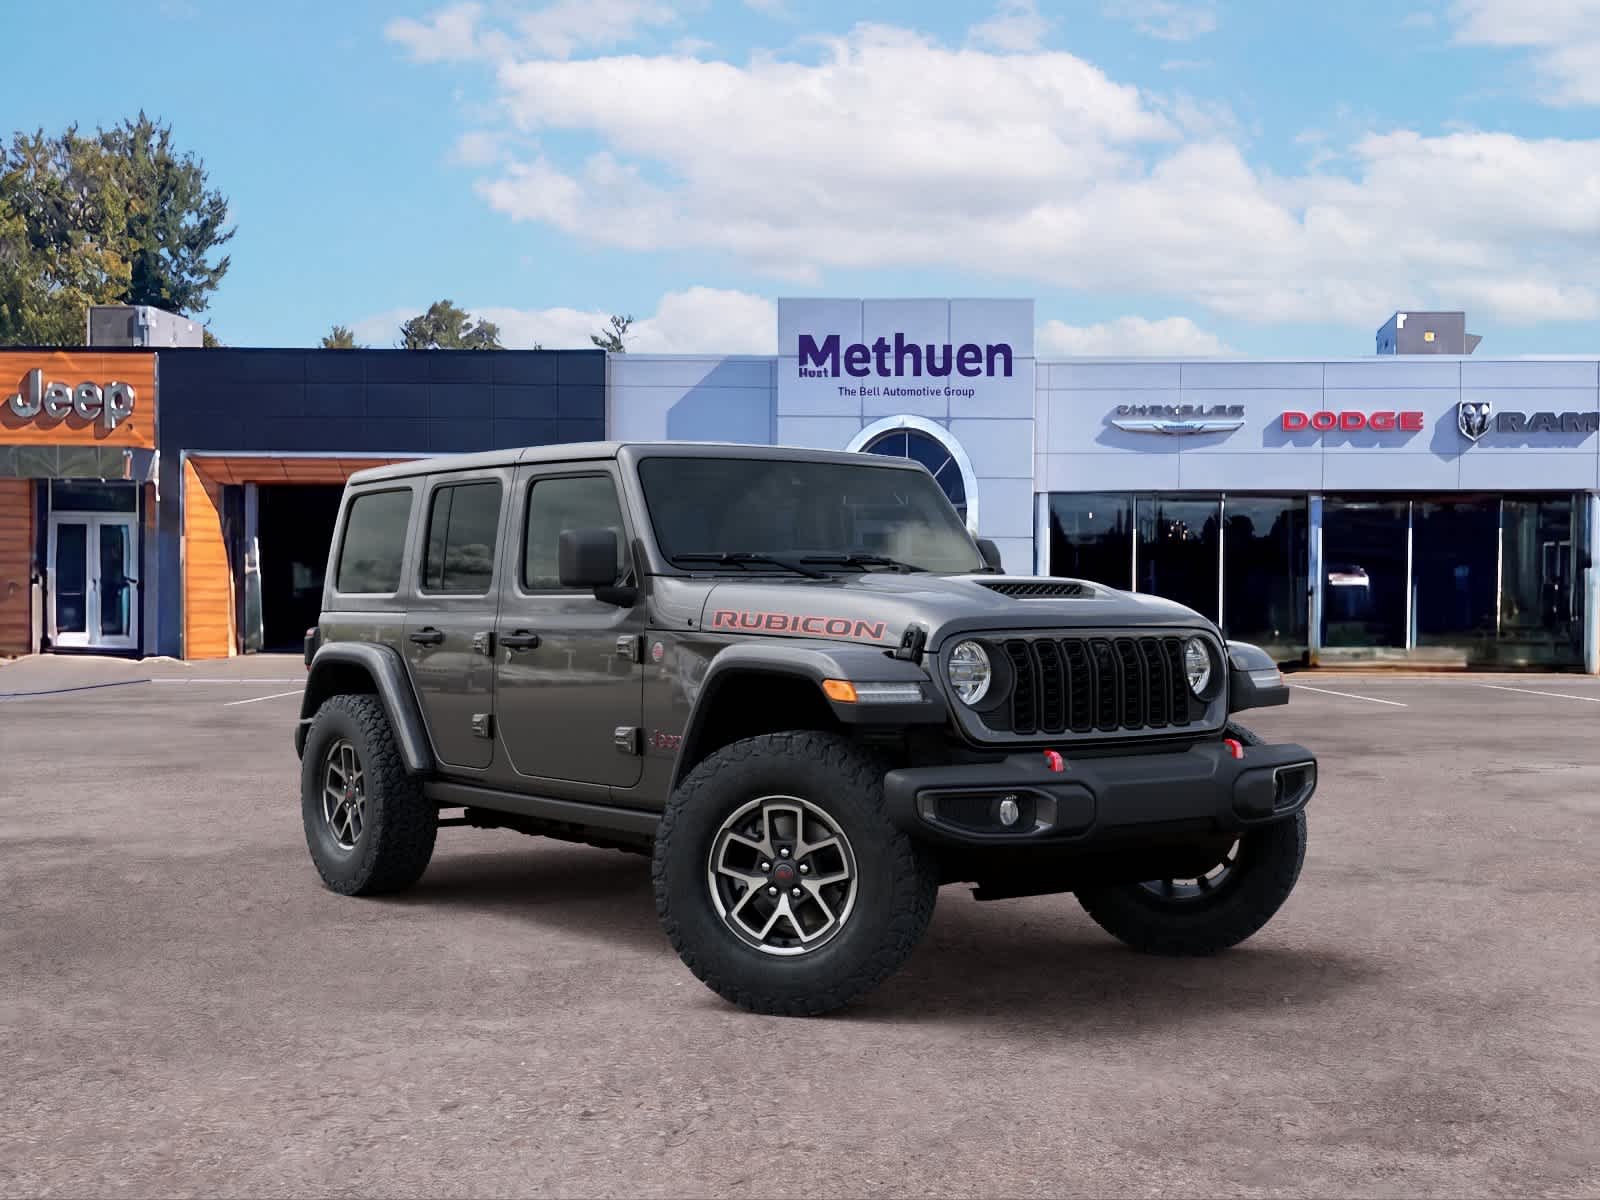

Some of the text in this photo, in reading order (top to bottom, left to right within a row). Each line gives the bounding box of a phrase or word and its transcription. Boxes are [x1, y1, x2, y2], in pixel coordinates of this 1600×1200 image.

[798, 332, 1013, 377] Methuen
[9, 368, 135, 429] Jeep
[838, 386, 975, 399] The Bell Automotive Group
[1282, 410, 1424, 432] DODGE
[1498, 411, 1600, 432] RAM
[713, 609, 887, 641] RUBICON
